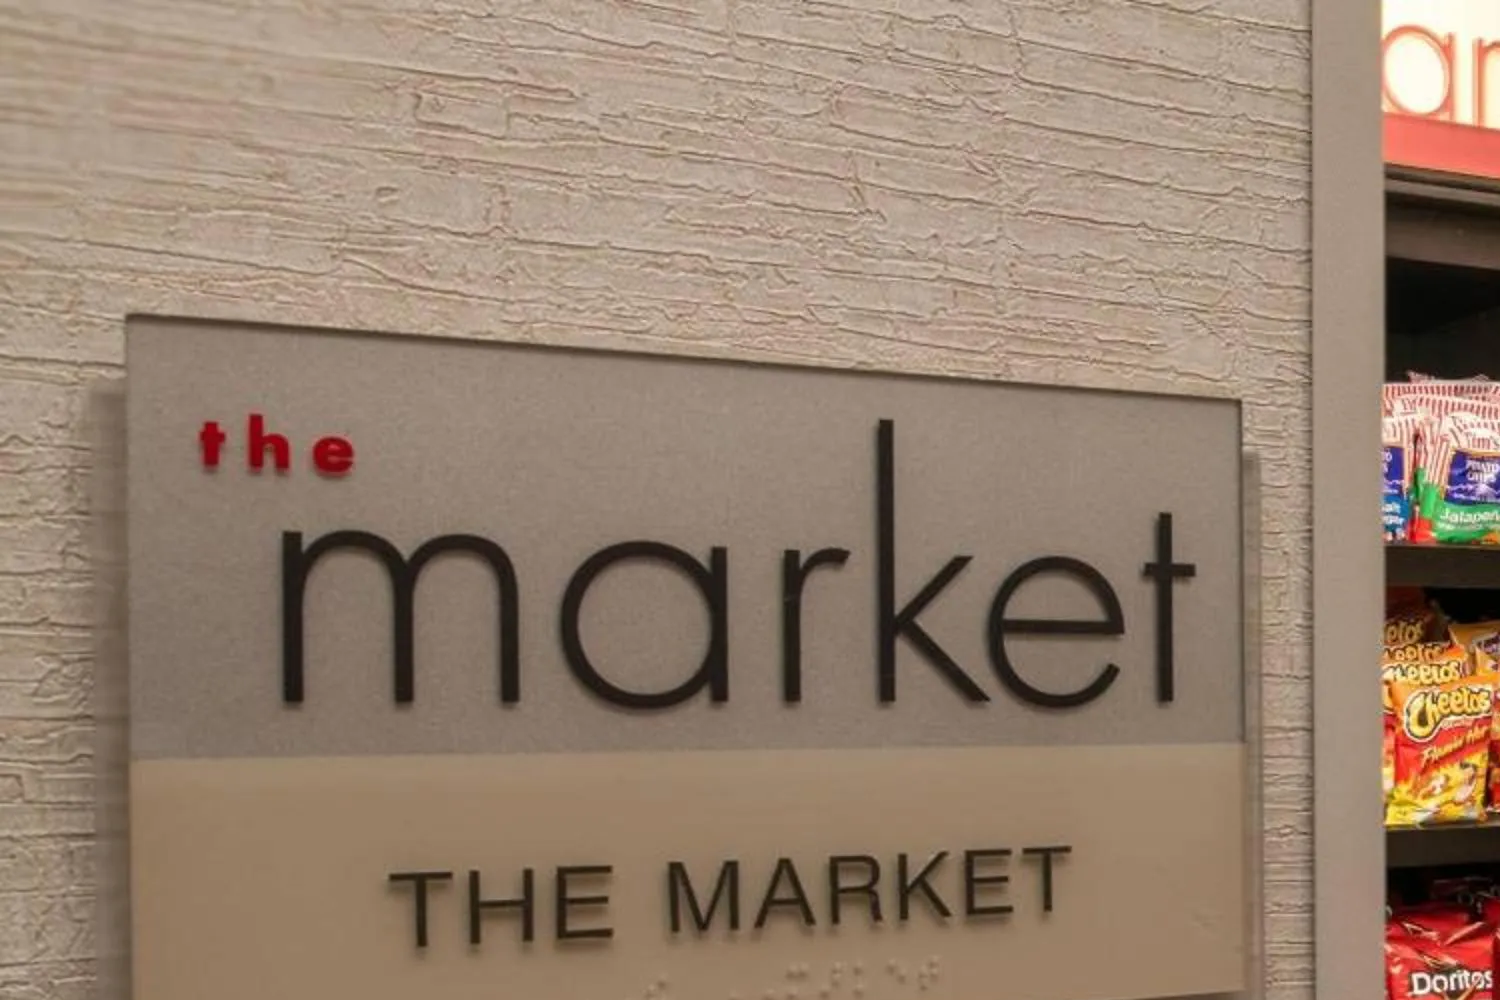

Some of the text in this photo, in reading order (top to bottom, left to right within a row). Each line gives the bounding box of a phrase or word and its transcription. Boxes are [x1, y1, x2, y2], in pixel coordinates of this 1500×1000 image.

[200, 414, 355, 474] the
[282, 418, 1196, 710] market
[1406, 687, 1491, 741] Cheetos
[388, 845, 1073, 948] THE MARKET
[1411, 969, 1492, 997] Doritos
